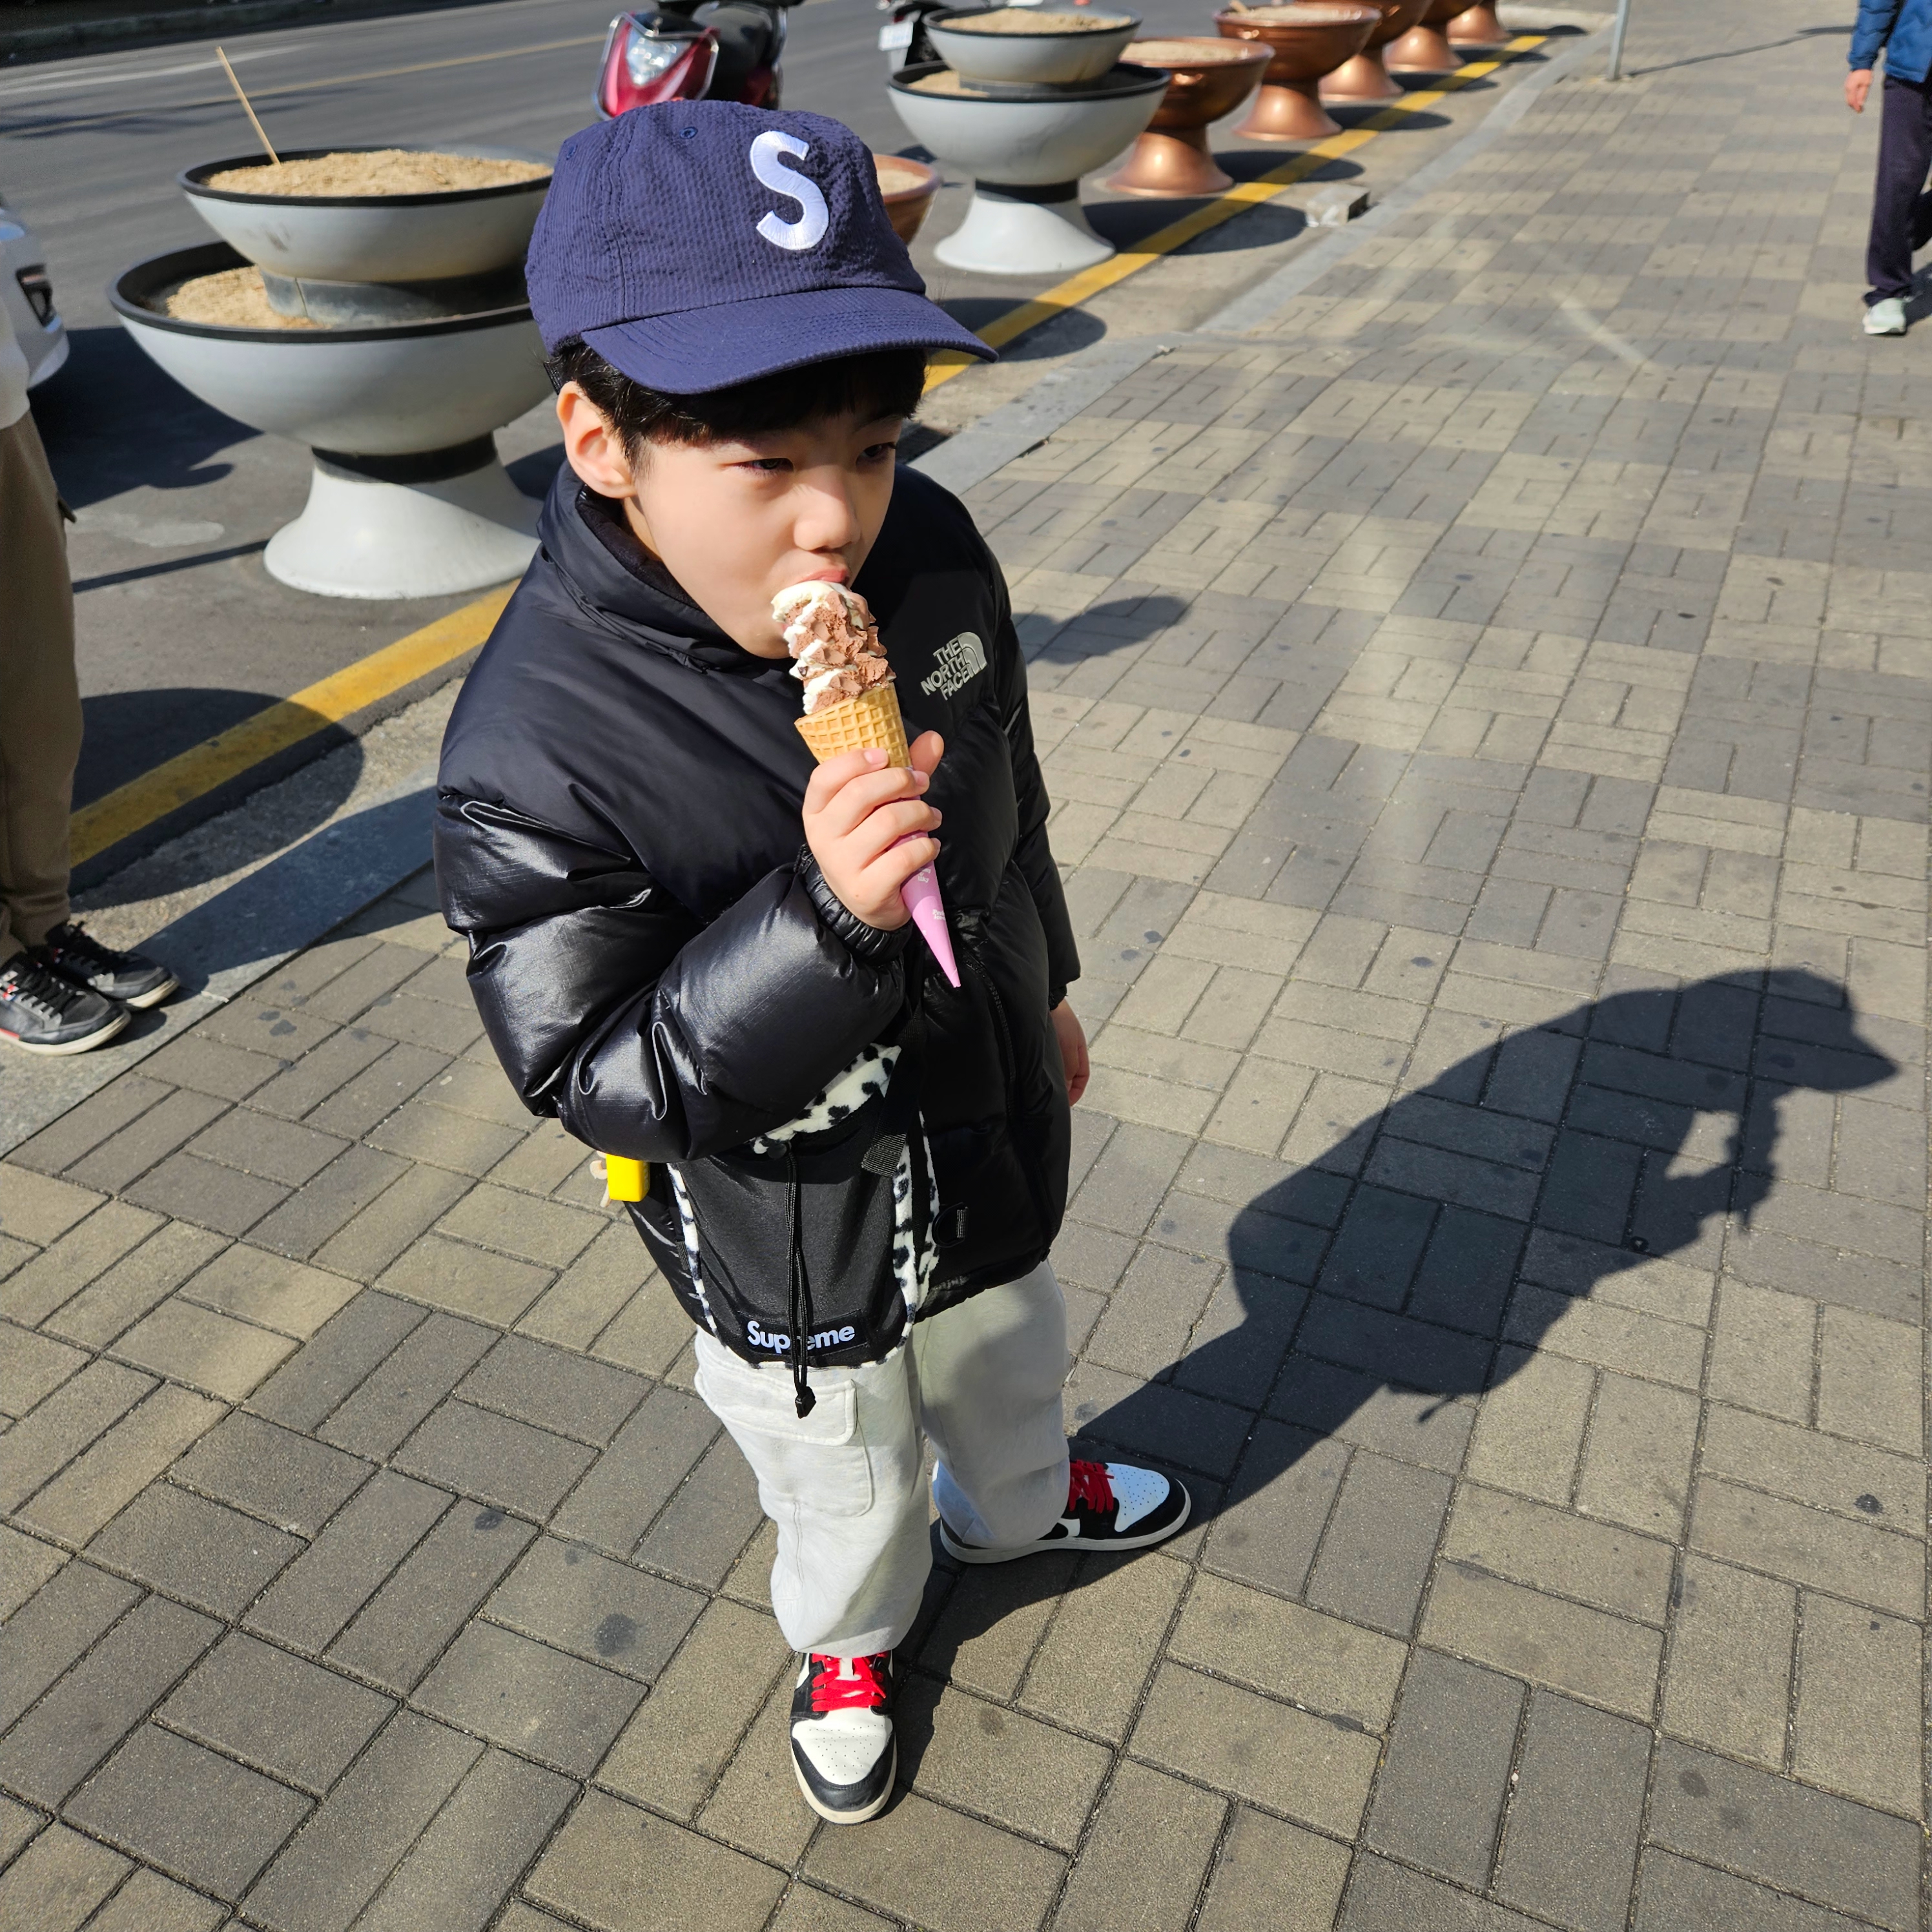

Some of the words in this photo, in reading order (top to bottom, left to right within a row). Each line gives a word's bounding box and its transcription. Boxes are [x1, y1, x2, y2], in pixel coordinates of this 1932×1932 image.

[750, 130, 830, 250] S
[932, 637, 962, 665] THE
[920, 651, 966, 696] NORTH
[940, 663, 971, 701] FACE
